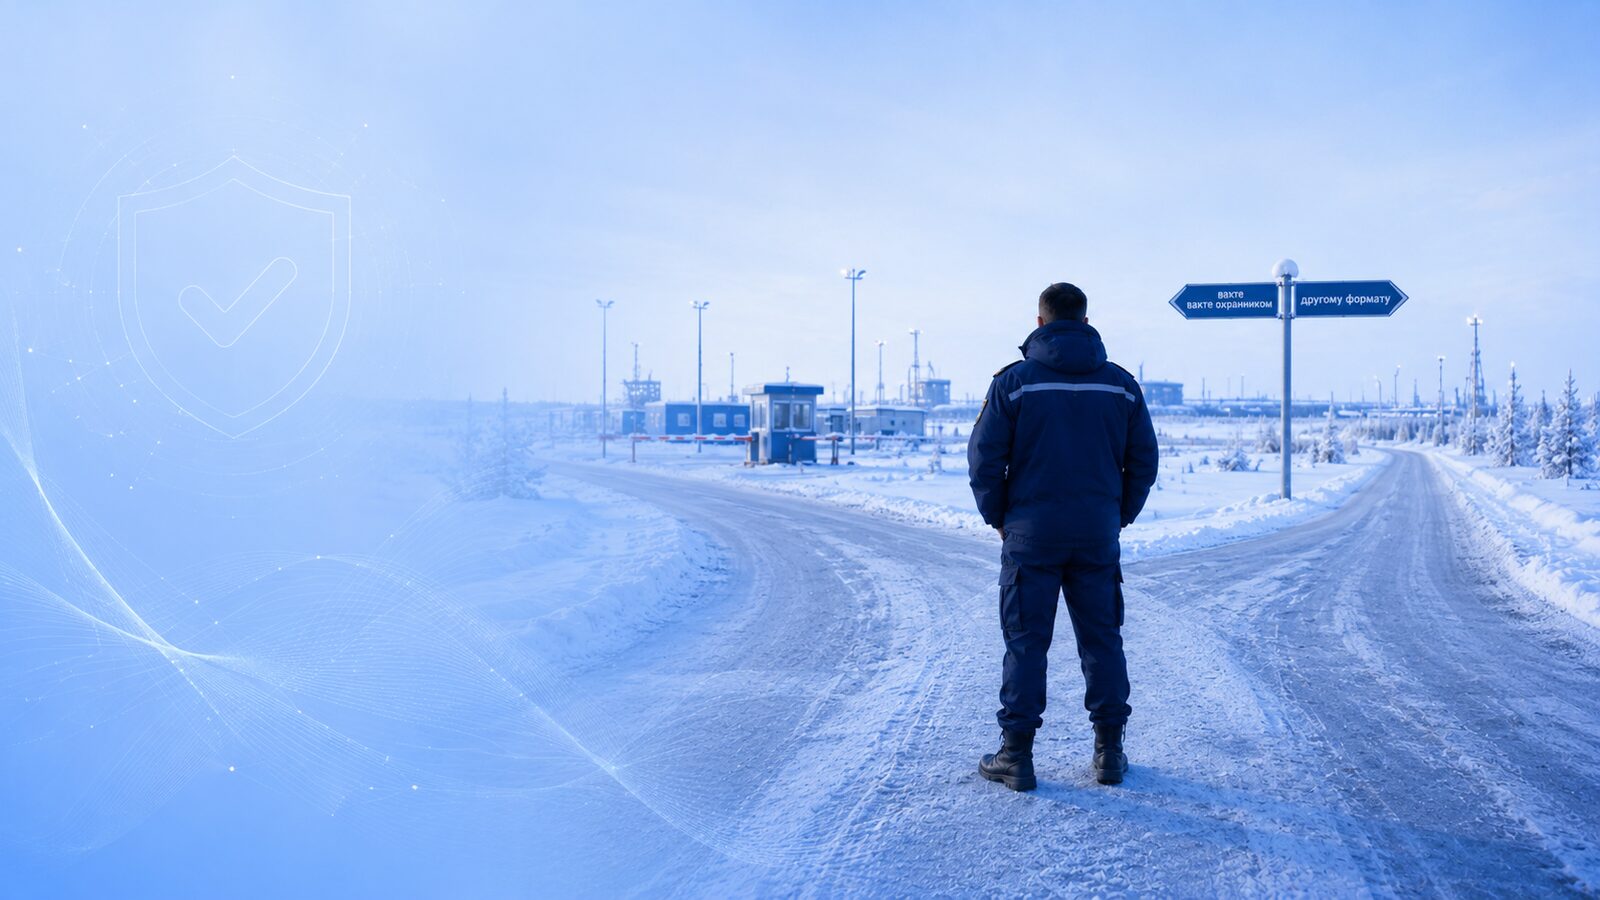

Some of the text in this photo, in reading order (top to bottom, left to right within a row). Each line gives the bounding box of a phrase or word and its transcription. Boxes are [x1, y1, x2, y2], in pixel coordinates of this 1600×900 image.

[1217, 291, 1244, 299] вахте
[1300, 294, 1391, 306] другому формату
[1216, 300, 1272, 310] охранником
